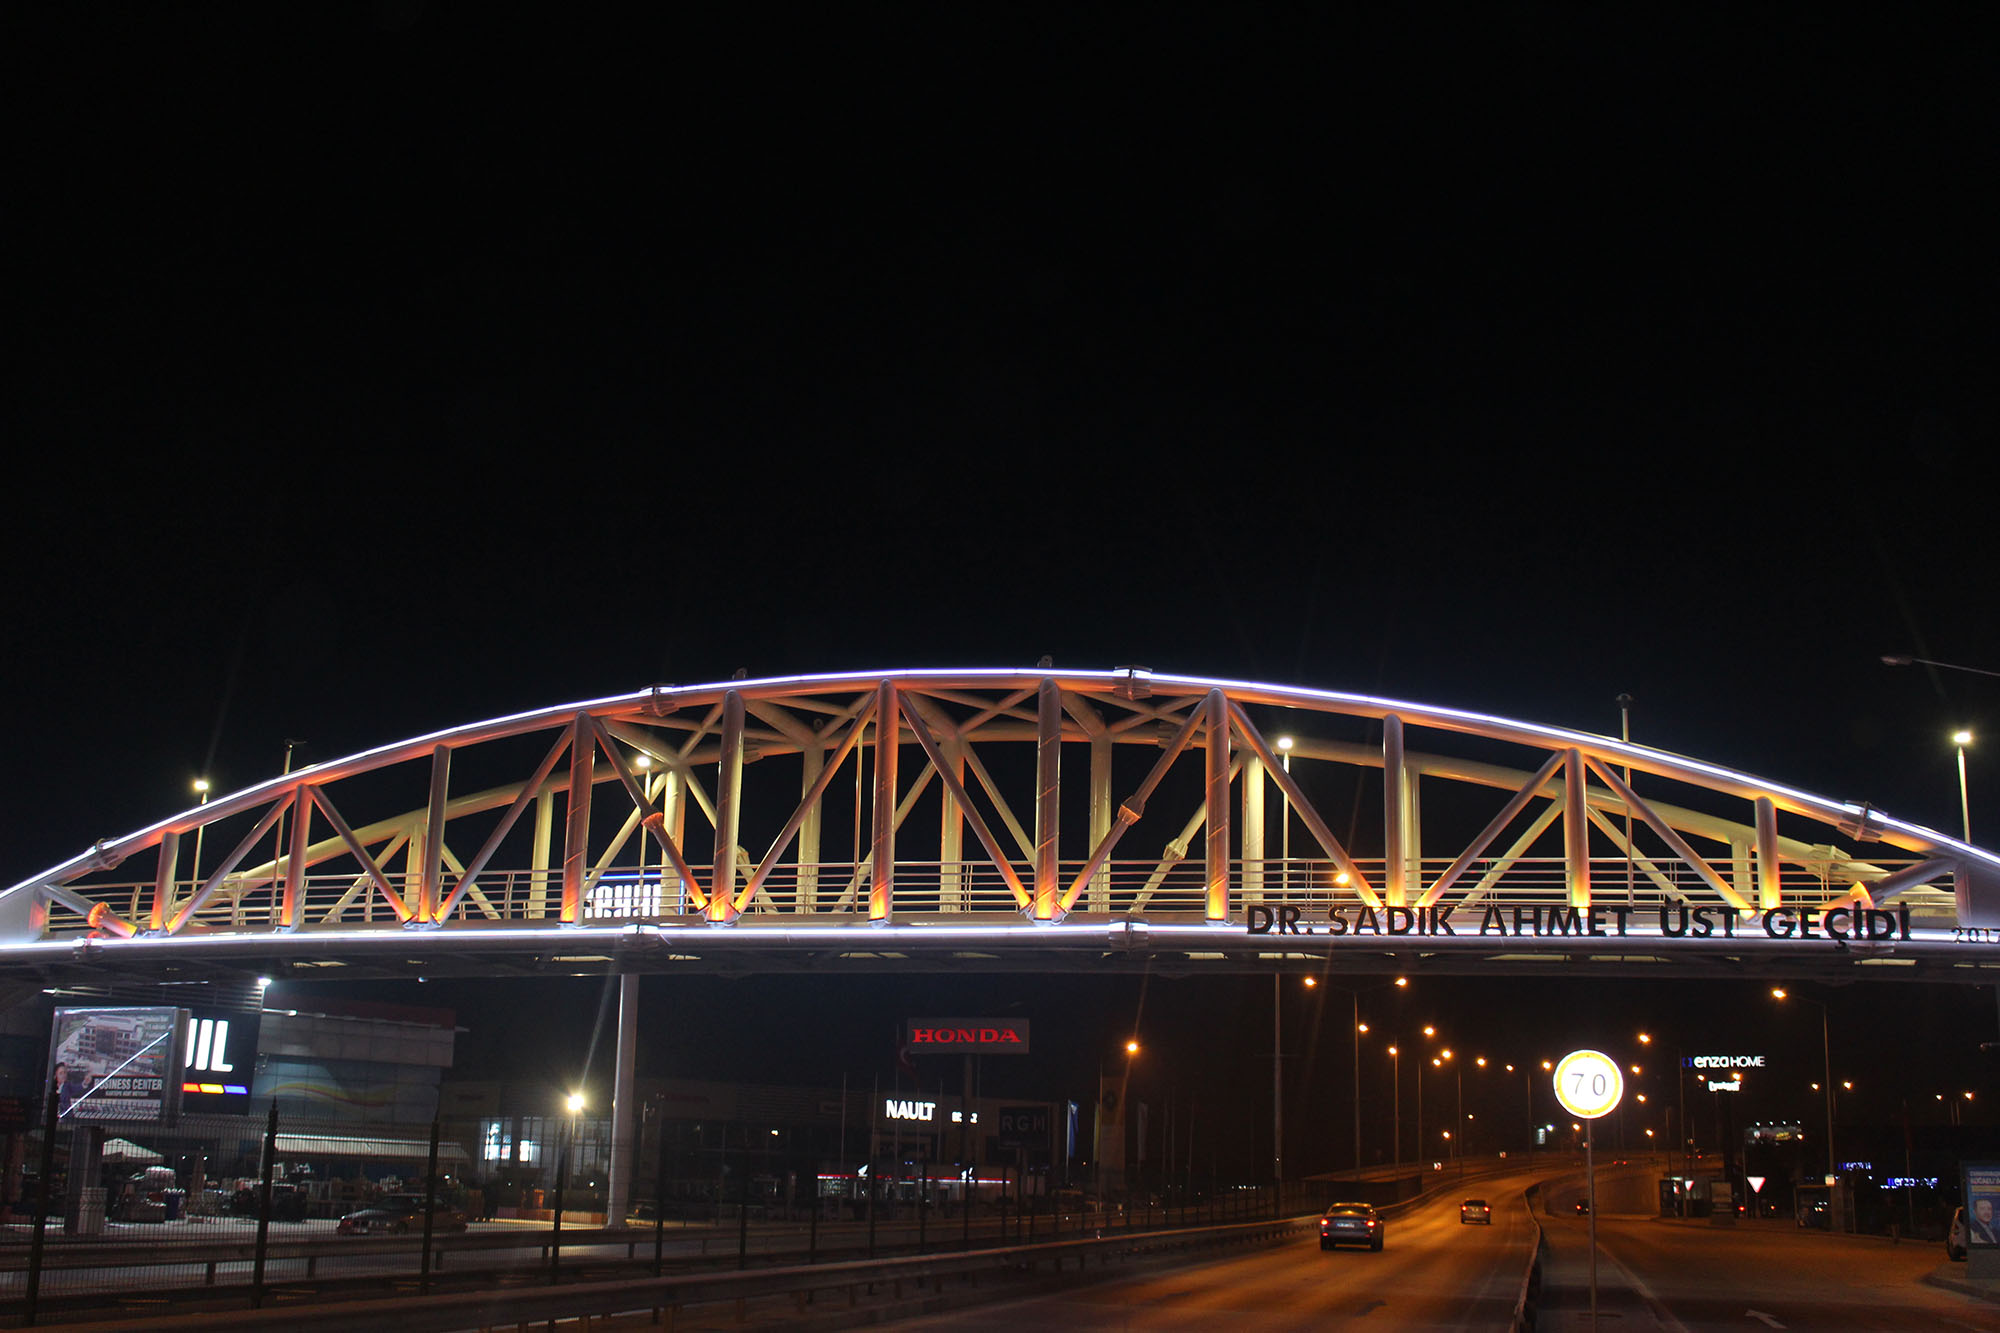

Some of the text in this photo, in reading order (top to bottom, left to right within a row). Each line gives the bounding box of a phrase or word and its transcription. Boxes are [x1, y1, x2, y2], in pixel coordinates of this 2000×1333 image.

[1247, 897, 1911, 953] DR. SADIK AHMET ÜST GEÇİDİ
[912, 1028, 1023, 1044] HONDA
[1693, 1055, 1766, 1068] enza HOME
[132, 1078, 163, 1090] CENTER
[1571, 1073, 1606, 1096] 70
